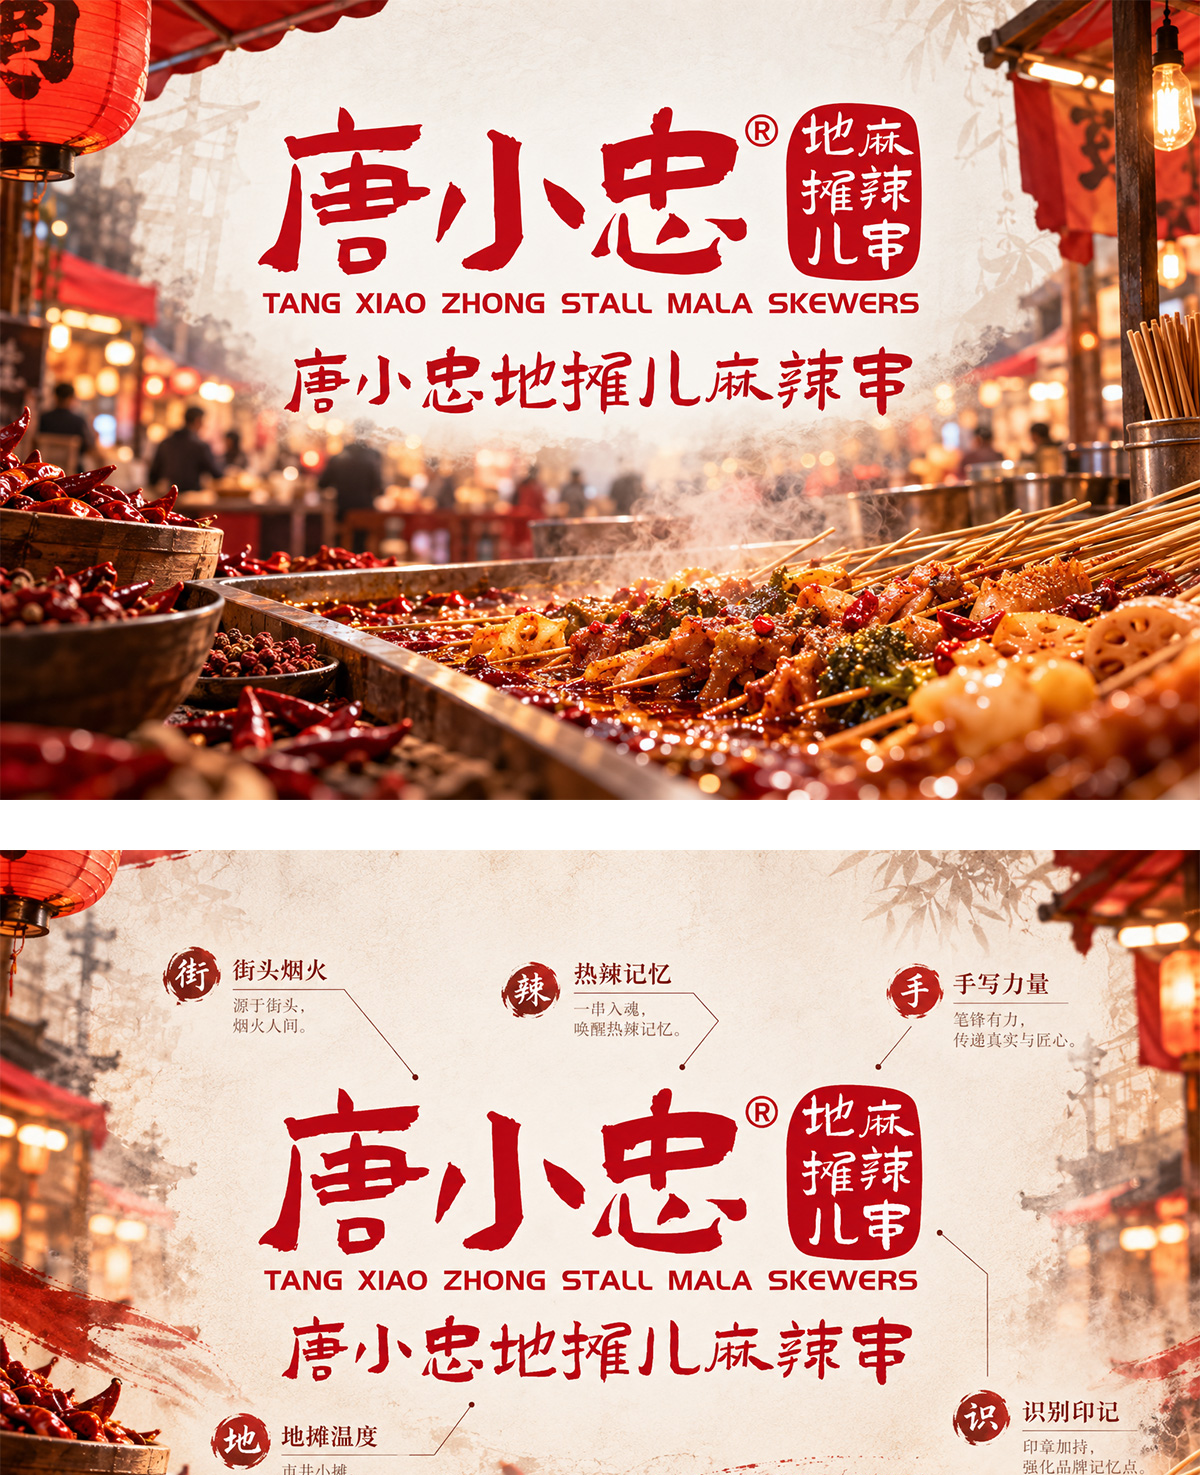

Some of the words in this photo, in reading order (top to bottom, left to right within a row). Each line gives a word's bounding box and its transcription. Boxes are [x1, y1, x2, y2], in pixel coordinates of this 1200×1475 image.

[258, 107, 747, 275] 唐小忠
[801, 112, 858, 265] 地摊儿
[858, 117, 914, 271] 麻辣串
[263, 293, 340, 313] TANG
[356, 293, 425, 313] XIAO
[442, 293, 544, 313] ZHONG
[562, 293, 652, 313] STALL
[668, 293, 753, 313] MALA
[769, 293, 919, 313] SKEWERS
[284, 346, 912, 416] 唐小忠地摊儿麻辣串
[175, 957, 209, 991] 街
[233, 959, 327, 981] 街头烟火
[575, 963, 671, 985] 热辣记忆
[514, 972, 551, 1007] 辣
[901, 973, 929, 1008] 手
[954, 973, 1048, 995] 手写力量
[234, 998, 304, 1013] 源于街头，
[574, 1001, 645, 1017] 一串入魂，
[233, 1018, 304, 1033] 烟火人间。
[574, 1022, 679, 1037] 唤醒热辣记忆。
[954, 1012, 1024, 1028] 笔锋有力，
[954, 1032, 1074, 1048] 传递真实与匠心。
[259, 1088, 747, 1255] 唐小忠
[801, 1092, 858, 1245] 地摊儿
[858, 1097, 914, 1251] 麻辣串
[264, 1270, 342, 1290] TANG
[358, 1270, 427, 1290] XIAO
[444, 1270, 545, 1290] ZHONG
[562, 1270, 652, 1290] STALL
[669, 1271, 752, 1290] MALA
[769, 1271, 917, 1290] SKEWERS
[282, 1315, 912, 1385] 唐小忠地摊儿麻辣串
[964, 1402, 998, 1431] 识
[1023, 1401, 1119, 1423] 识别印记
[224, 1425, 261, 1454] 地
[282, 1425, 377, 1447] 地摊温度
[1024, 1439, 1093, 1455] 印章加持，
[1023, 1459, 1145, 1475] 强化品牌记忆点。
